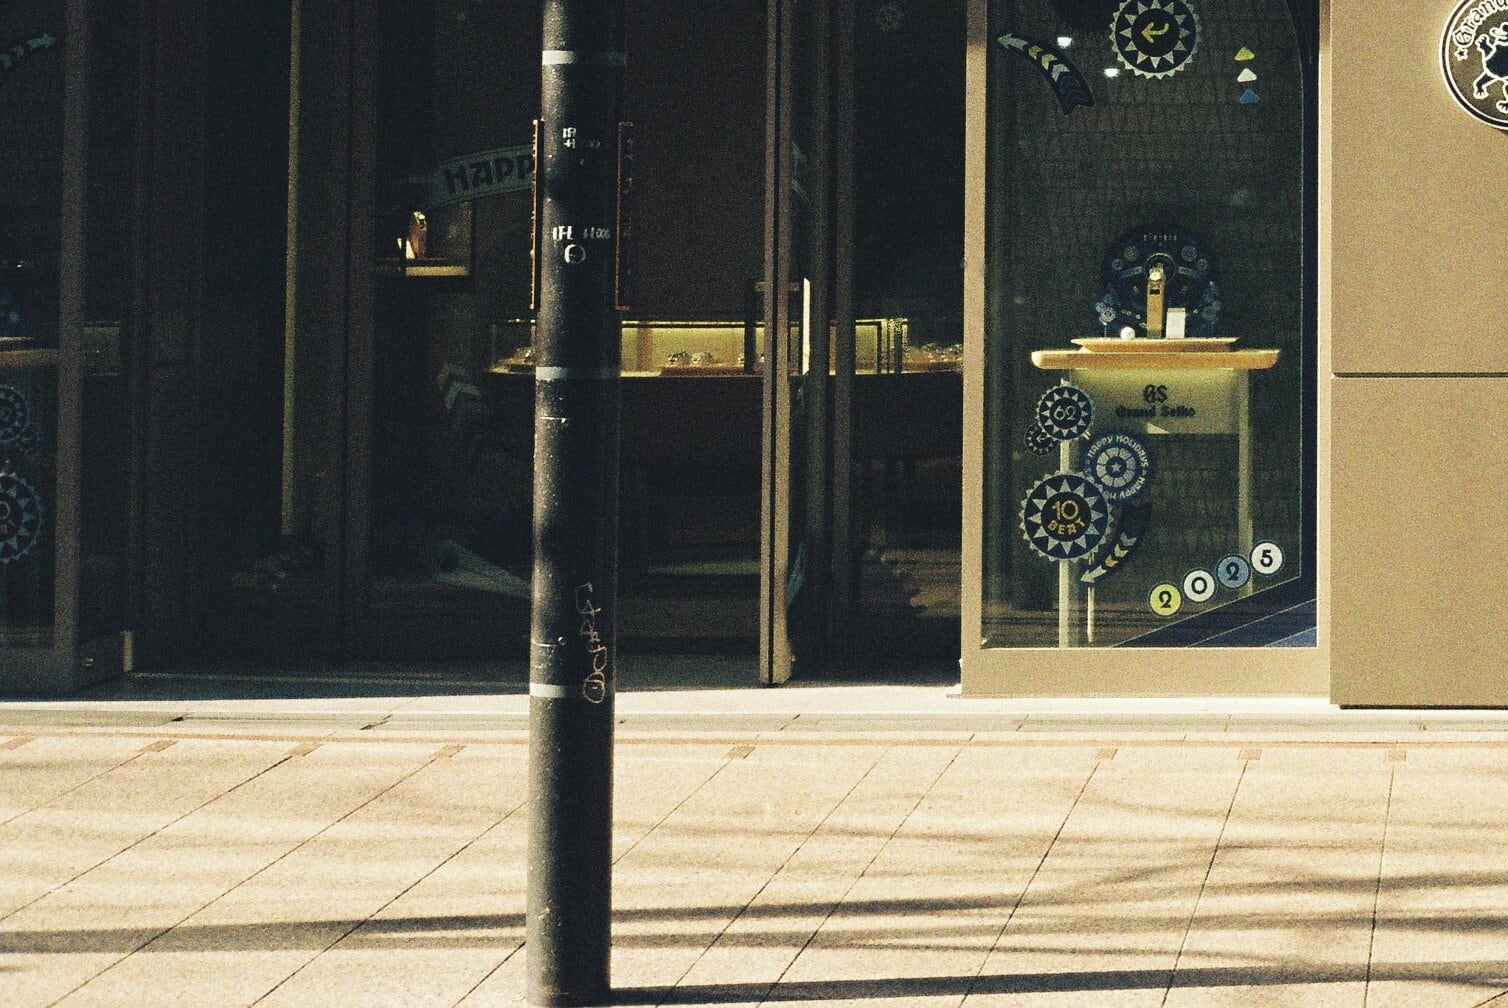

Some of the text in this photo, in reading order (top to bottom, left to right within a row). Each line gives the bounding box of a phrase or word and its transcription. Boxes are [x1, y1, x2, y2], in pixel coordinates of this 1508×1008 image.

[444, 154, 535, 194] HAPP
[1053, 405, 1076, 421] 62
[1052, 499, 1079, 521] 10
[1048, 517, 1086, 535] BEAT
